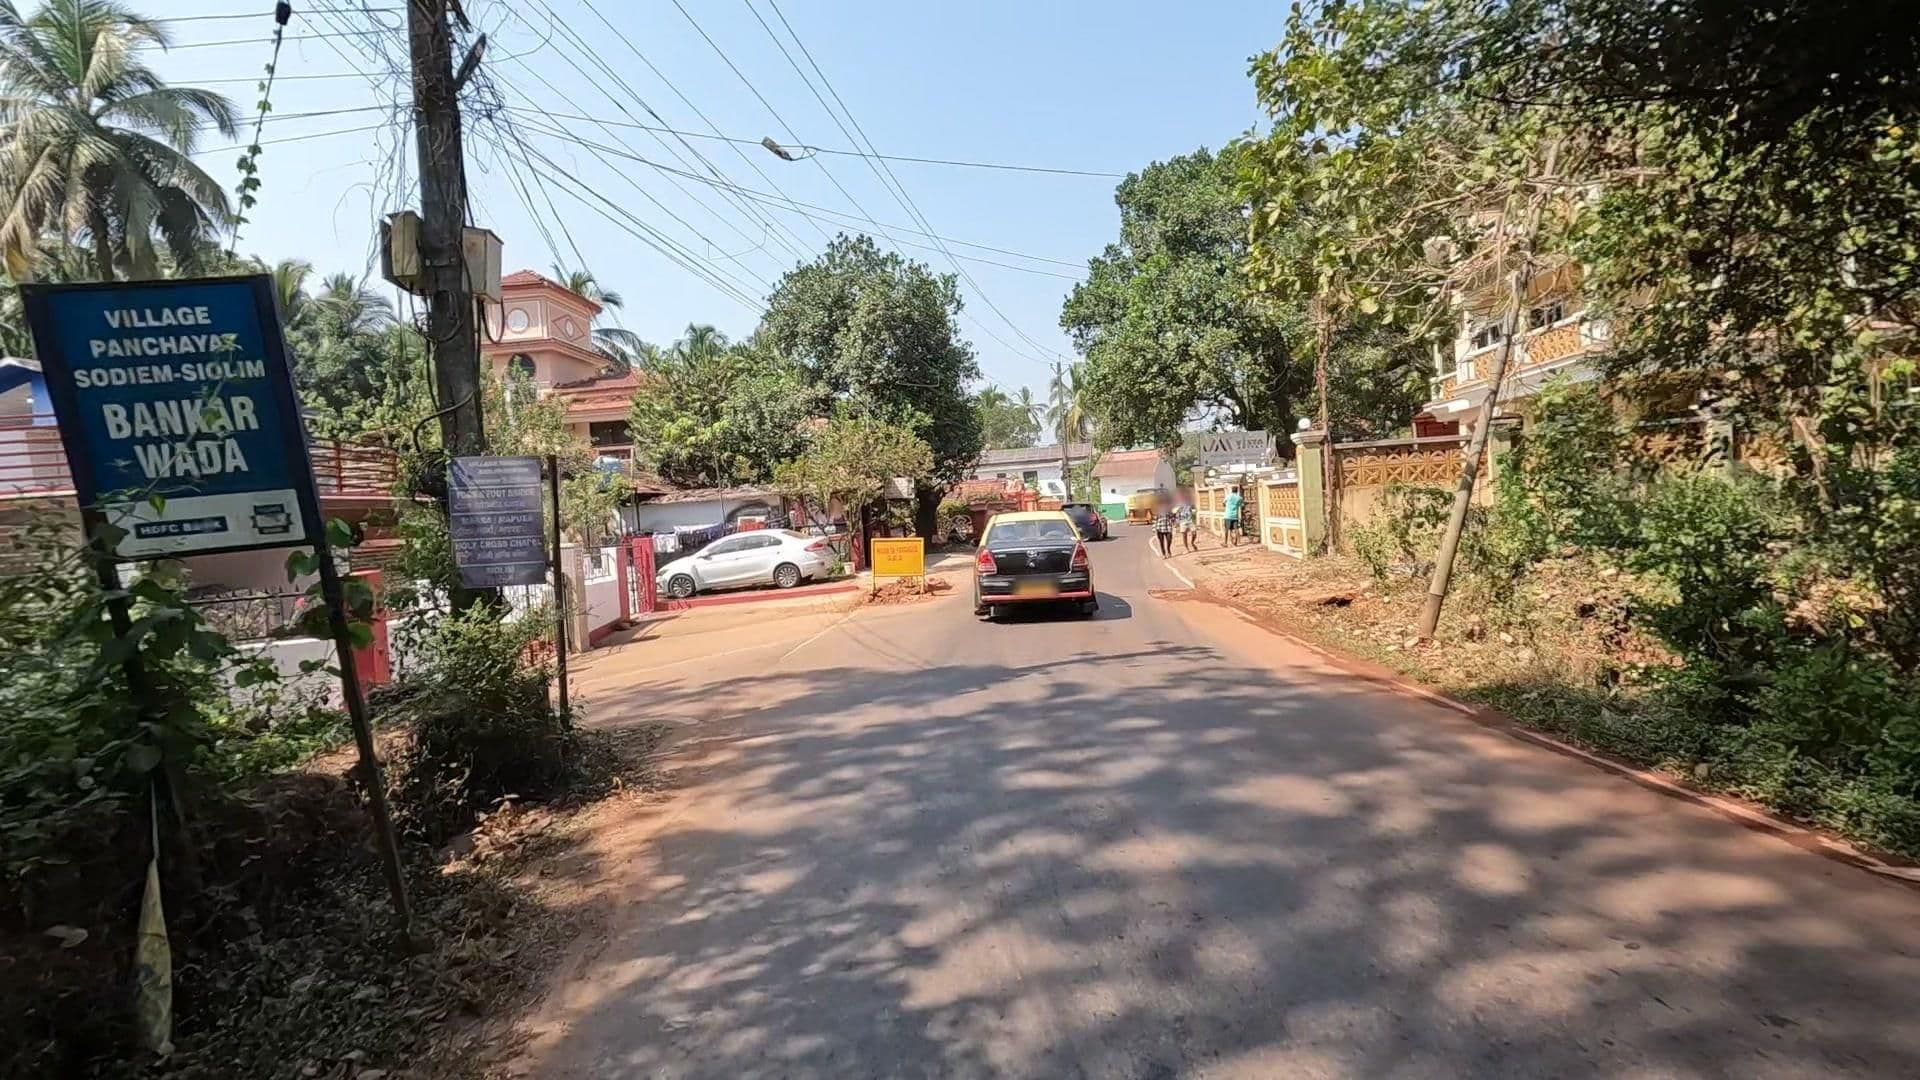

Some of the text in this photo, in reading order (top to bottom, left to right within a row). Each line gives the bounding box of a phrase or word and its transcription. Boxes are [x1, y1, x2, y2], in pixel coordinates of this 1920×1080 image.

[103, 306, 212, 329] VILLAGE
[73, 360, 266, 389] SODIEM-SIOLIM
[102, 396, 260, 440] BANKAR
[134, 438, 249, 479] WADA
[140, 520, 223, 535] HDFC BK
